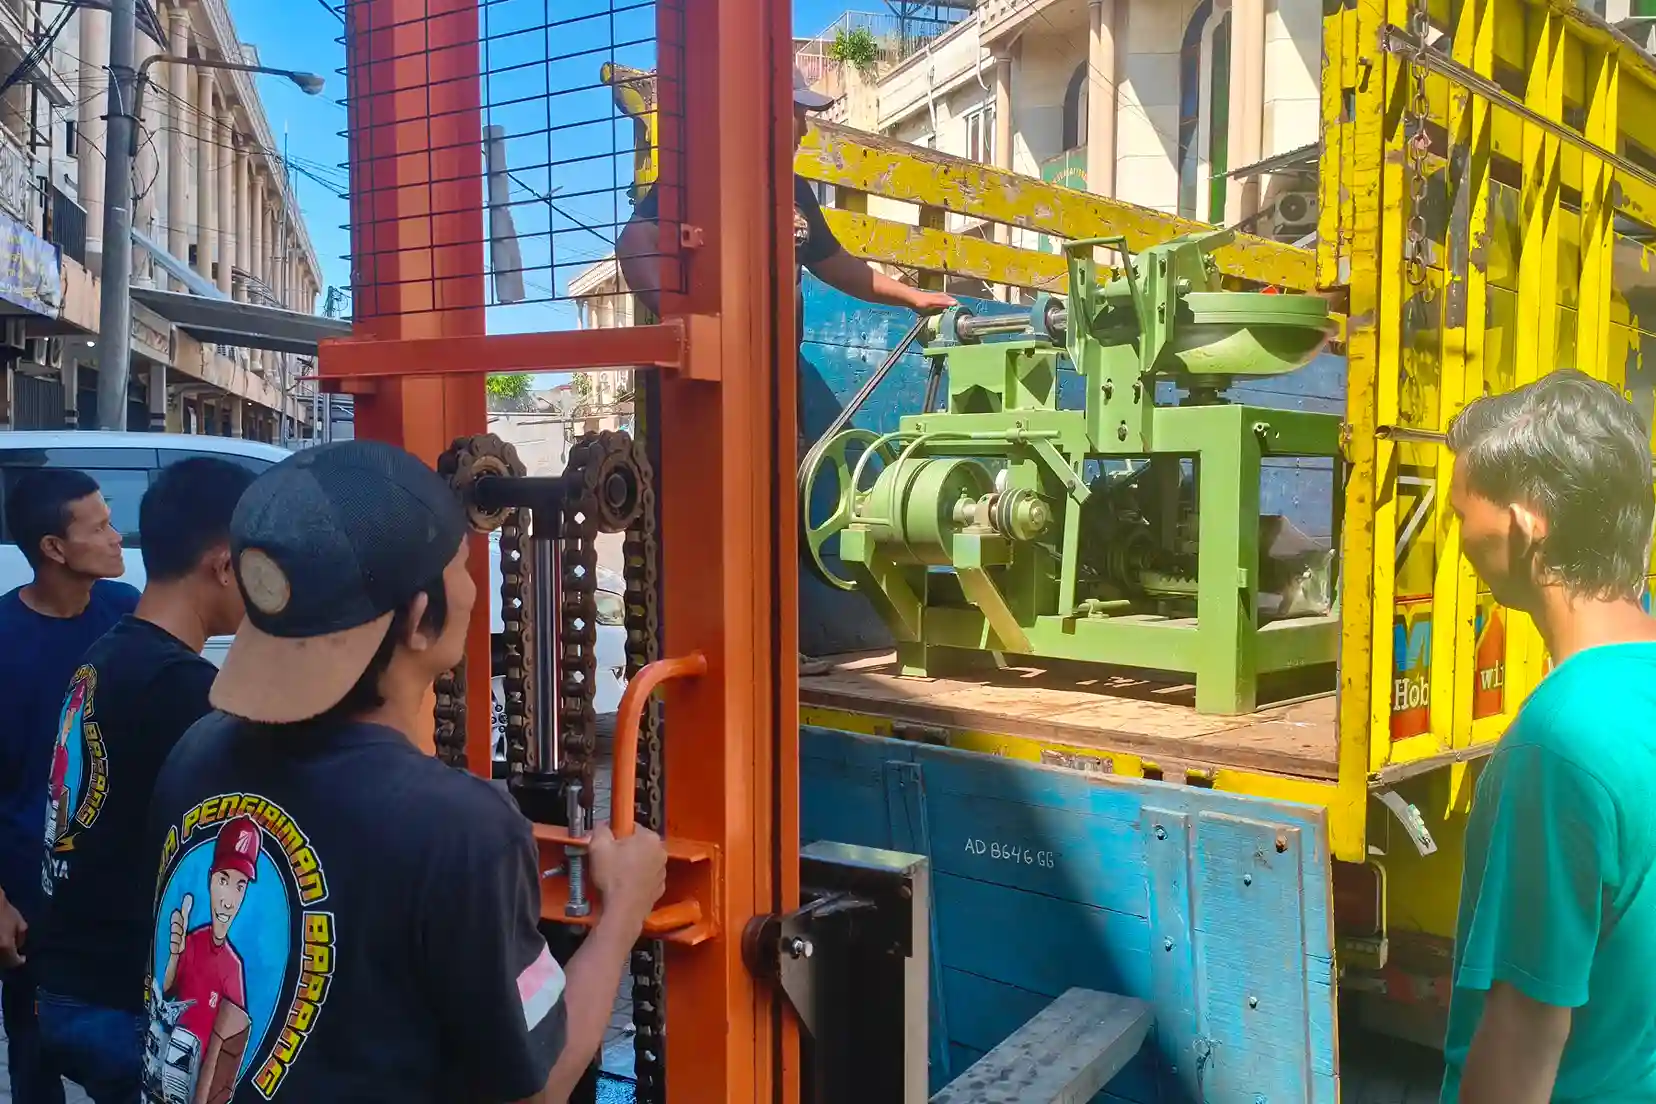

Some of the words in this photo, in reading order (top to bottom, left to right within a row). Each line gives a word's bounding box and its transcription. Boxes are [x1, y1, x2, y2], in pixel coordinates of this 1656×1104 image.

[181, 793, 329, 906] PENGIRIMAN
[964, 838, 986, 854] AD
[251, 911, 336, 1100] BARANG
